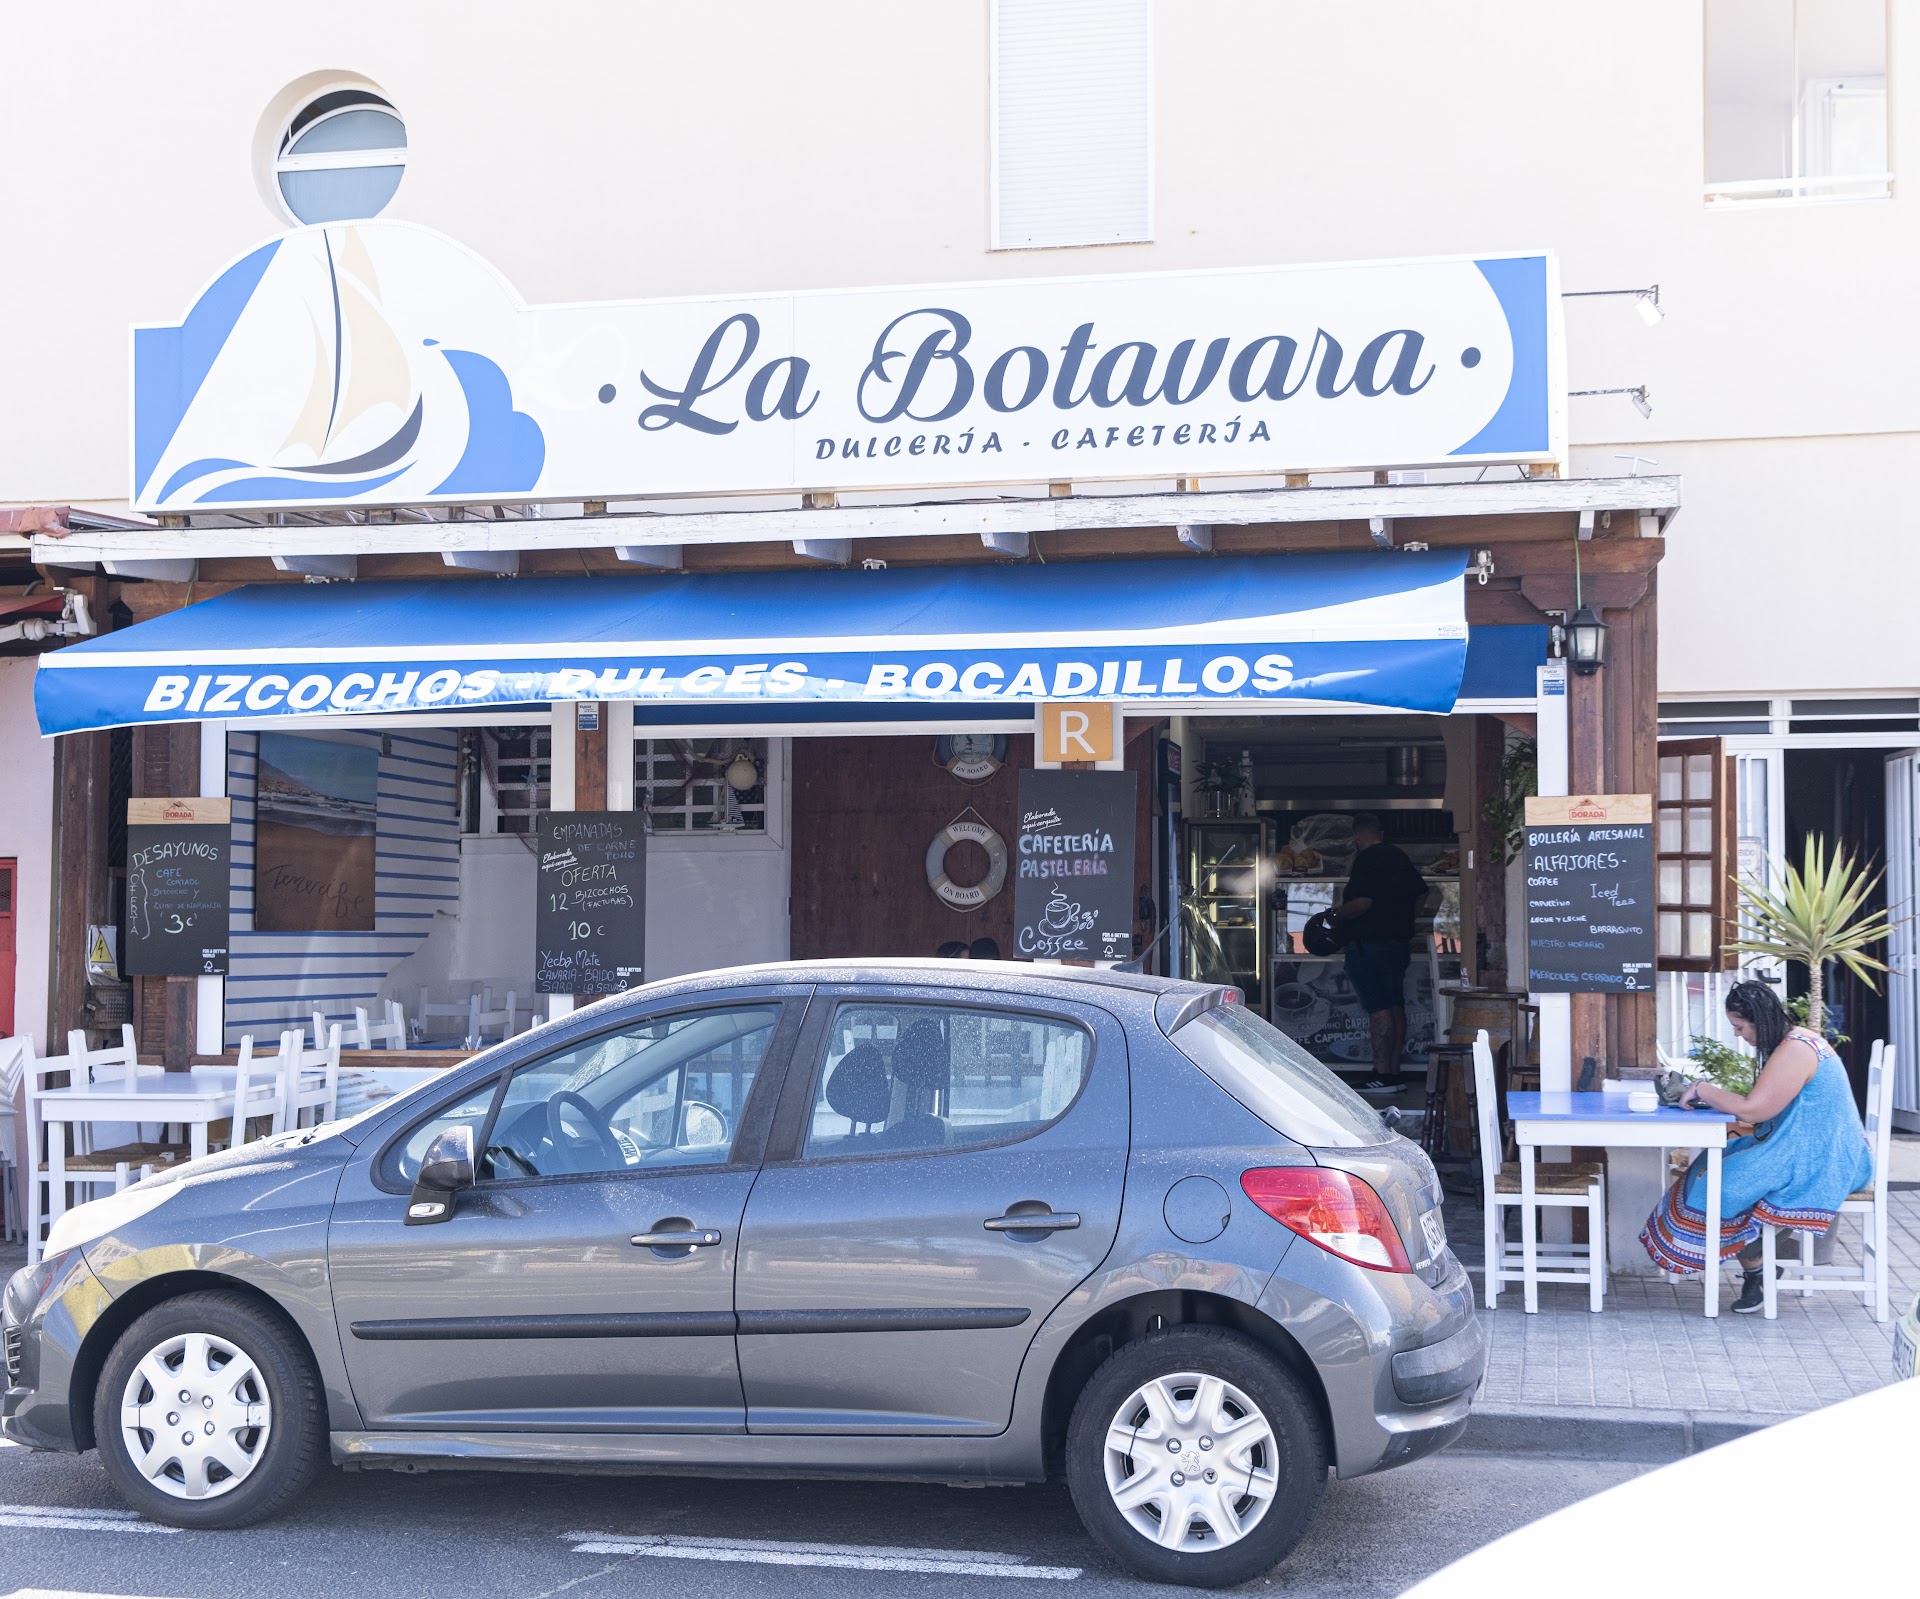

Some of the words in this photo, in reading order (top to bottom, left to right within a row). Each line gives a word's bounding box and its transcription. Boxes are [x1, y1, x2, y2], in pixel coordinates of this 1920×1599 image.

[638, 313, 820, 436] La
[857, 308, 1436, 424] Botavara
[816, 427, 1003, 460] DULCERÍA
[1051, 415, 1271, 450] CAFETERÍA
[144, 668, 500, 713] BIZCOCHOS
[547, 661, 809, 696] DULCES
[865, 653, 1295, 698] BOCADILLOS
[1058, 710, 1096, 755] R
[966, 764, 989, 774] BOARD
[1571, 811, 1604, 819] DORADA
[553, 822, 623, 842] EMPANADAS
[952, 825, 987, 837] WELCOME
[1529, 828, 1580, 847] BOLLERÍA
[1588, 828, 1645, 841] ARTESANAL
[577, 843, 593, 852] DE
[597, 839, 636, 852] CARNE
[1019, 828, 1114, 855] CAFETERÍA
[132, 842, 219, 870] DESAYUNOS
[156, 868, 182, 878] CAFE
[561, 864, 617, 887] OFERTA
[1020, 853, 1108, 879] PASTELERÍA
[262, 864, 375, 918] Tenerife
[550, 892, 569, 912] 12
[571, 884, 629, 905] BIZCOCHOS
[943, 886, 954, 897] ON
[954, 889, 981, 899] BOARD
[1590, 883, 1619, 898] Iced
[1562, 915, 1587, 923] LECHE
[568, 920, 591, 940] 10
[1589, 925, 1643, 935] BARRAQUITO
[1019, 926, 1089, 958] Coffee
[1530, 939, 1566, 949] NUESTRO
[1567, 941, 1605, 950] HORARIO
[575, 949, 601, 969] Mate
[537, 968, 577, 982] CANARIA
[542, 981, 573, 994] SARA
[583, 983, 594, 994] LA
[1314, 1031, 1371, 1044] CAPPUCCIN
